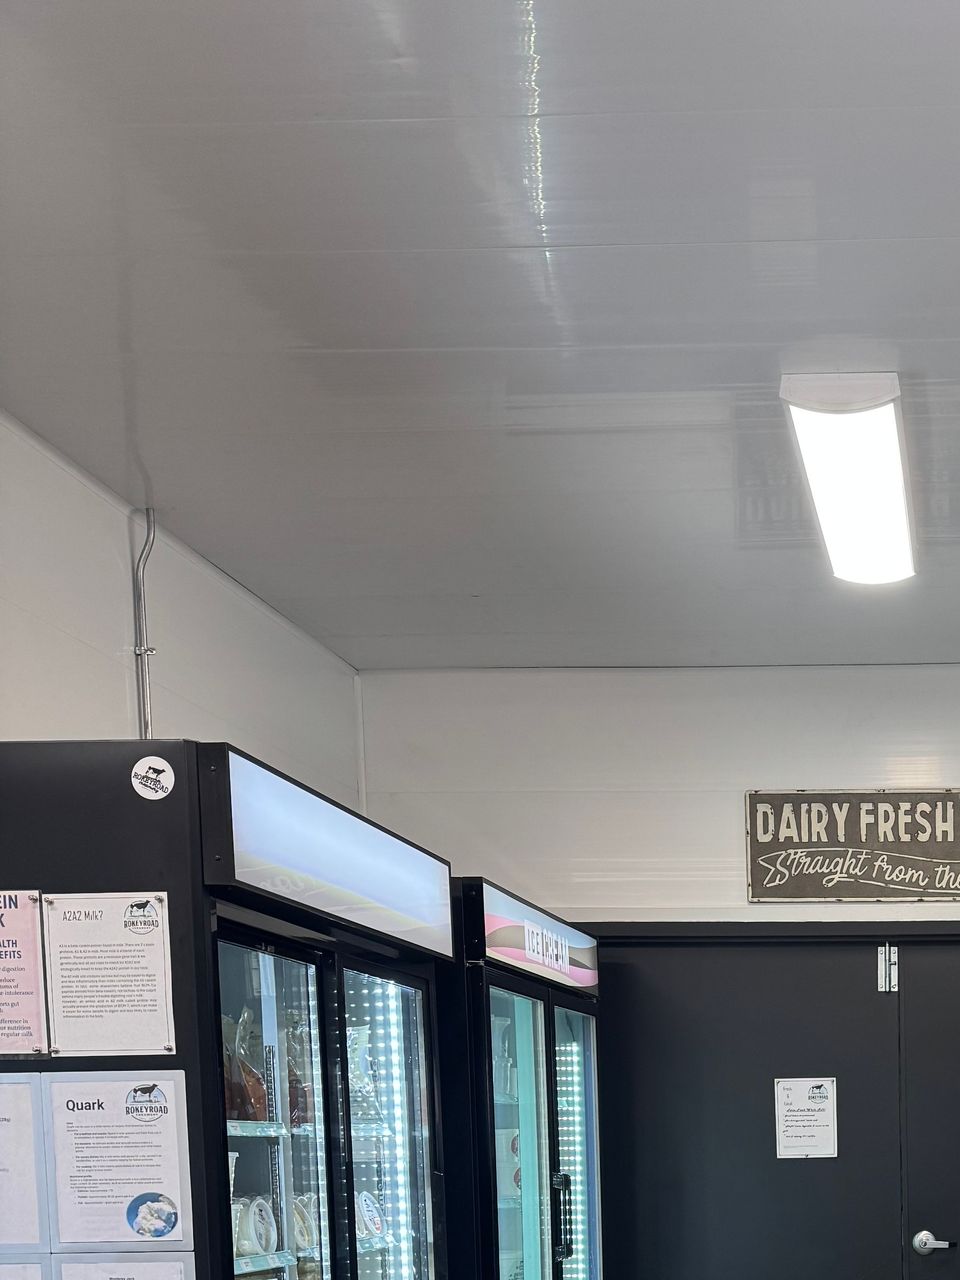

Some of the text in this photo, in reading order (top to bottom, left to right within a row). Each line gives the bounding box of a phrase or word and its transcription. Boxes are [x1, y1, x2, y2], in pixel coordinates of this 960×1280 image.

[756, 803, 850, 843] DAIRY
[860, 802, 955, 843] FRESH
[775, 849, 873, 888] Straight
[873, 855, 930, 882] from
[62, 909, 104, 921] A2A2 Milk?
[124, 920, 159, 929] ROKEYROAD
[527, 929, 541, 955] ICE
[66, 1099, 105, 1112] Quark
[125, 1105, 168, 1115] ROKEYROAD
